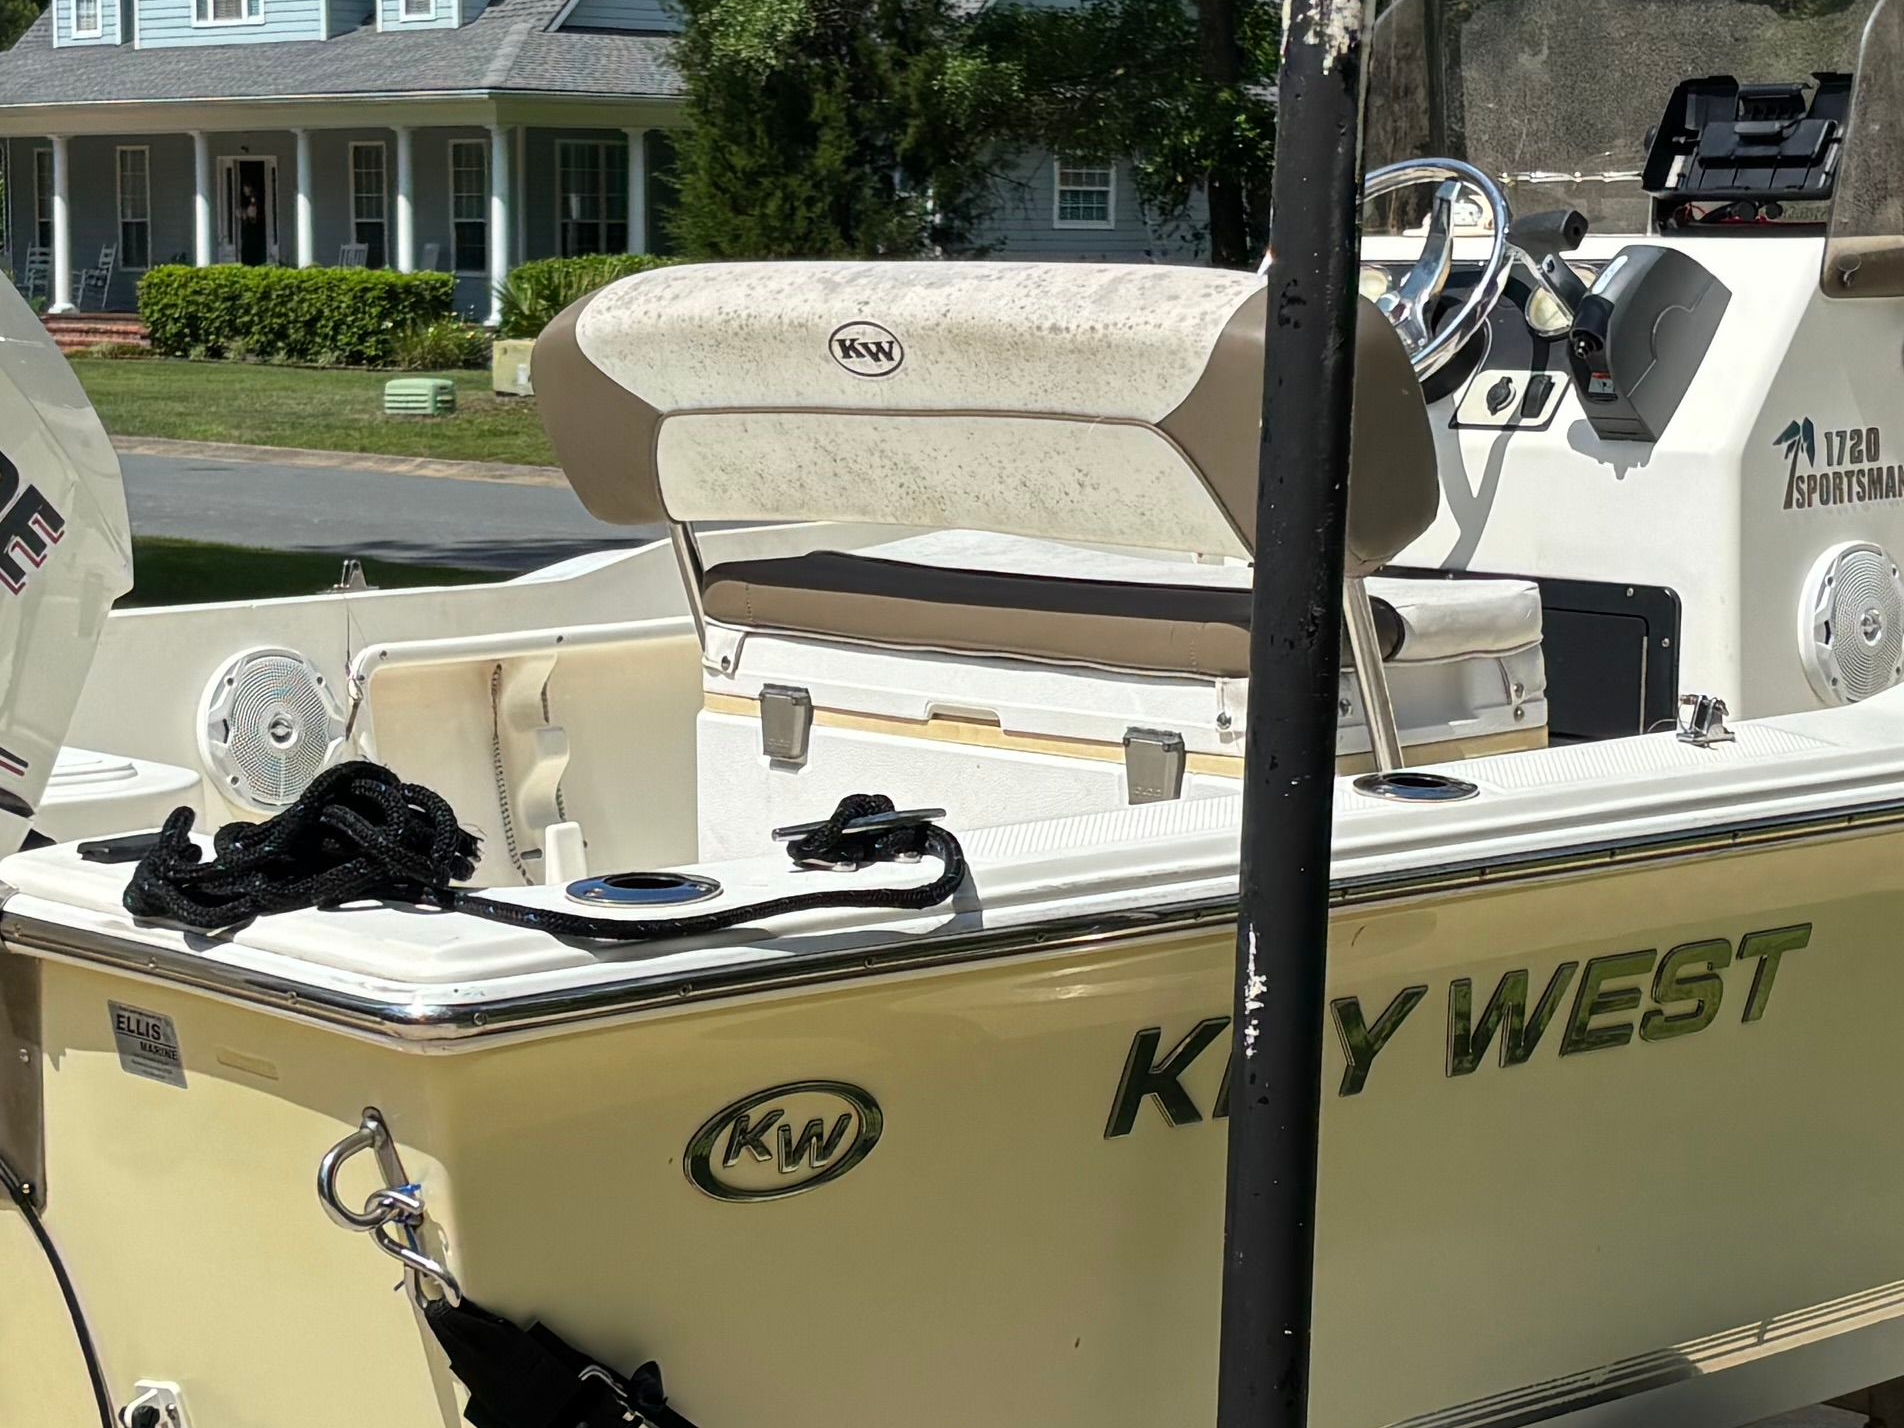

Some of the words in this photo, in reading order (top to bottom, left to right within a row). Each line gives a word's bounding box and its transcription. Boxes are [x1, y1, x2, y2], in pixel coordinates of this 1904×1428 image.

[834, 337, 895, 363] KW
[1824, 427, 1881, 467] 1720
[116, 1013, 161, 1041] ELLIS
[1102, 983, 1429, 1140] KY
[1444, 922, 1813, 1079] WEST
[139, 1041, 178, 1061] MARINE
[722, 1108, 853, 1174] KW
